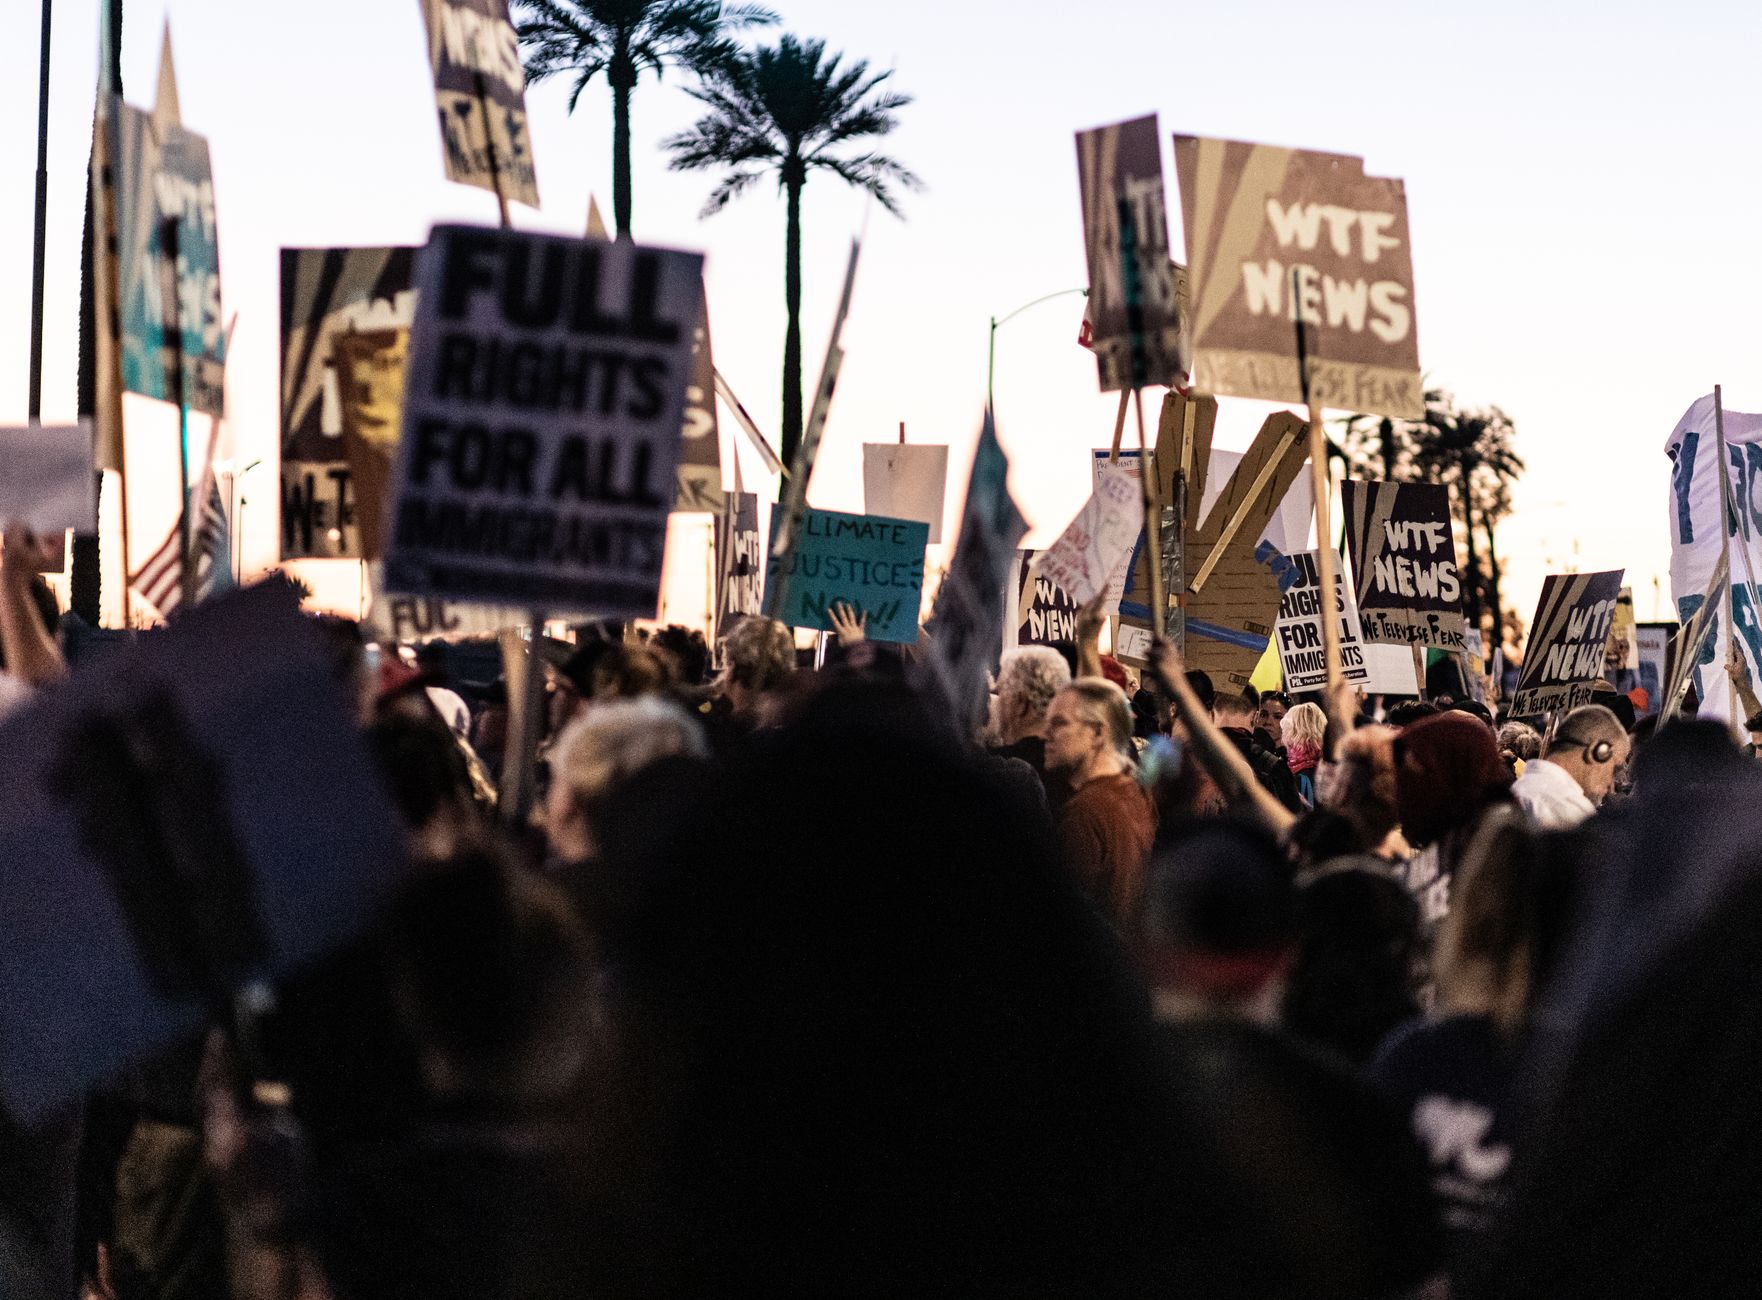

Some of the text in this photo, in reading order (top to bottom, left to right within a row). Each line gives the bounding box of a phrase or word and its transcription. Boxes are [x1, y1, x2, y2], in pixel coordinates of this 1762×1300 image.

[1266, 198, 1400, 263] WTF
[442, 224, 681, 344] FULL
[1242, 258, 1410, 343] NEWS
[435, 331, 671, 421] RIGHTS
[409, 413, 663, 507] FOR ALL
[806, 514, 908, 545] LIMATE
[1384, 521, 1448, 553] WTF
[1374, 553, 1460, 602] NEWS
[1028, 607, 1078, 640] NEW
[1280, 588, 1345, 619] RIGHS
[1565, 600, 1617, 643] WTF
[1279, 622, 1321, 651] FOR
[1360, 613, 1379, 640] WE
[1377, 612, 1429, 643] TELEVISE
[1427, 614, 1468, 649] FEAR
[1285, 646, 1363, 674] IMMIGNTS
[1541, 642, 1606, 682] NEWS
